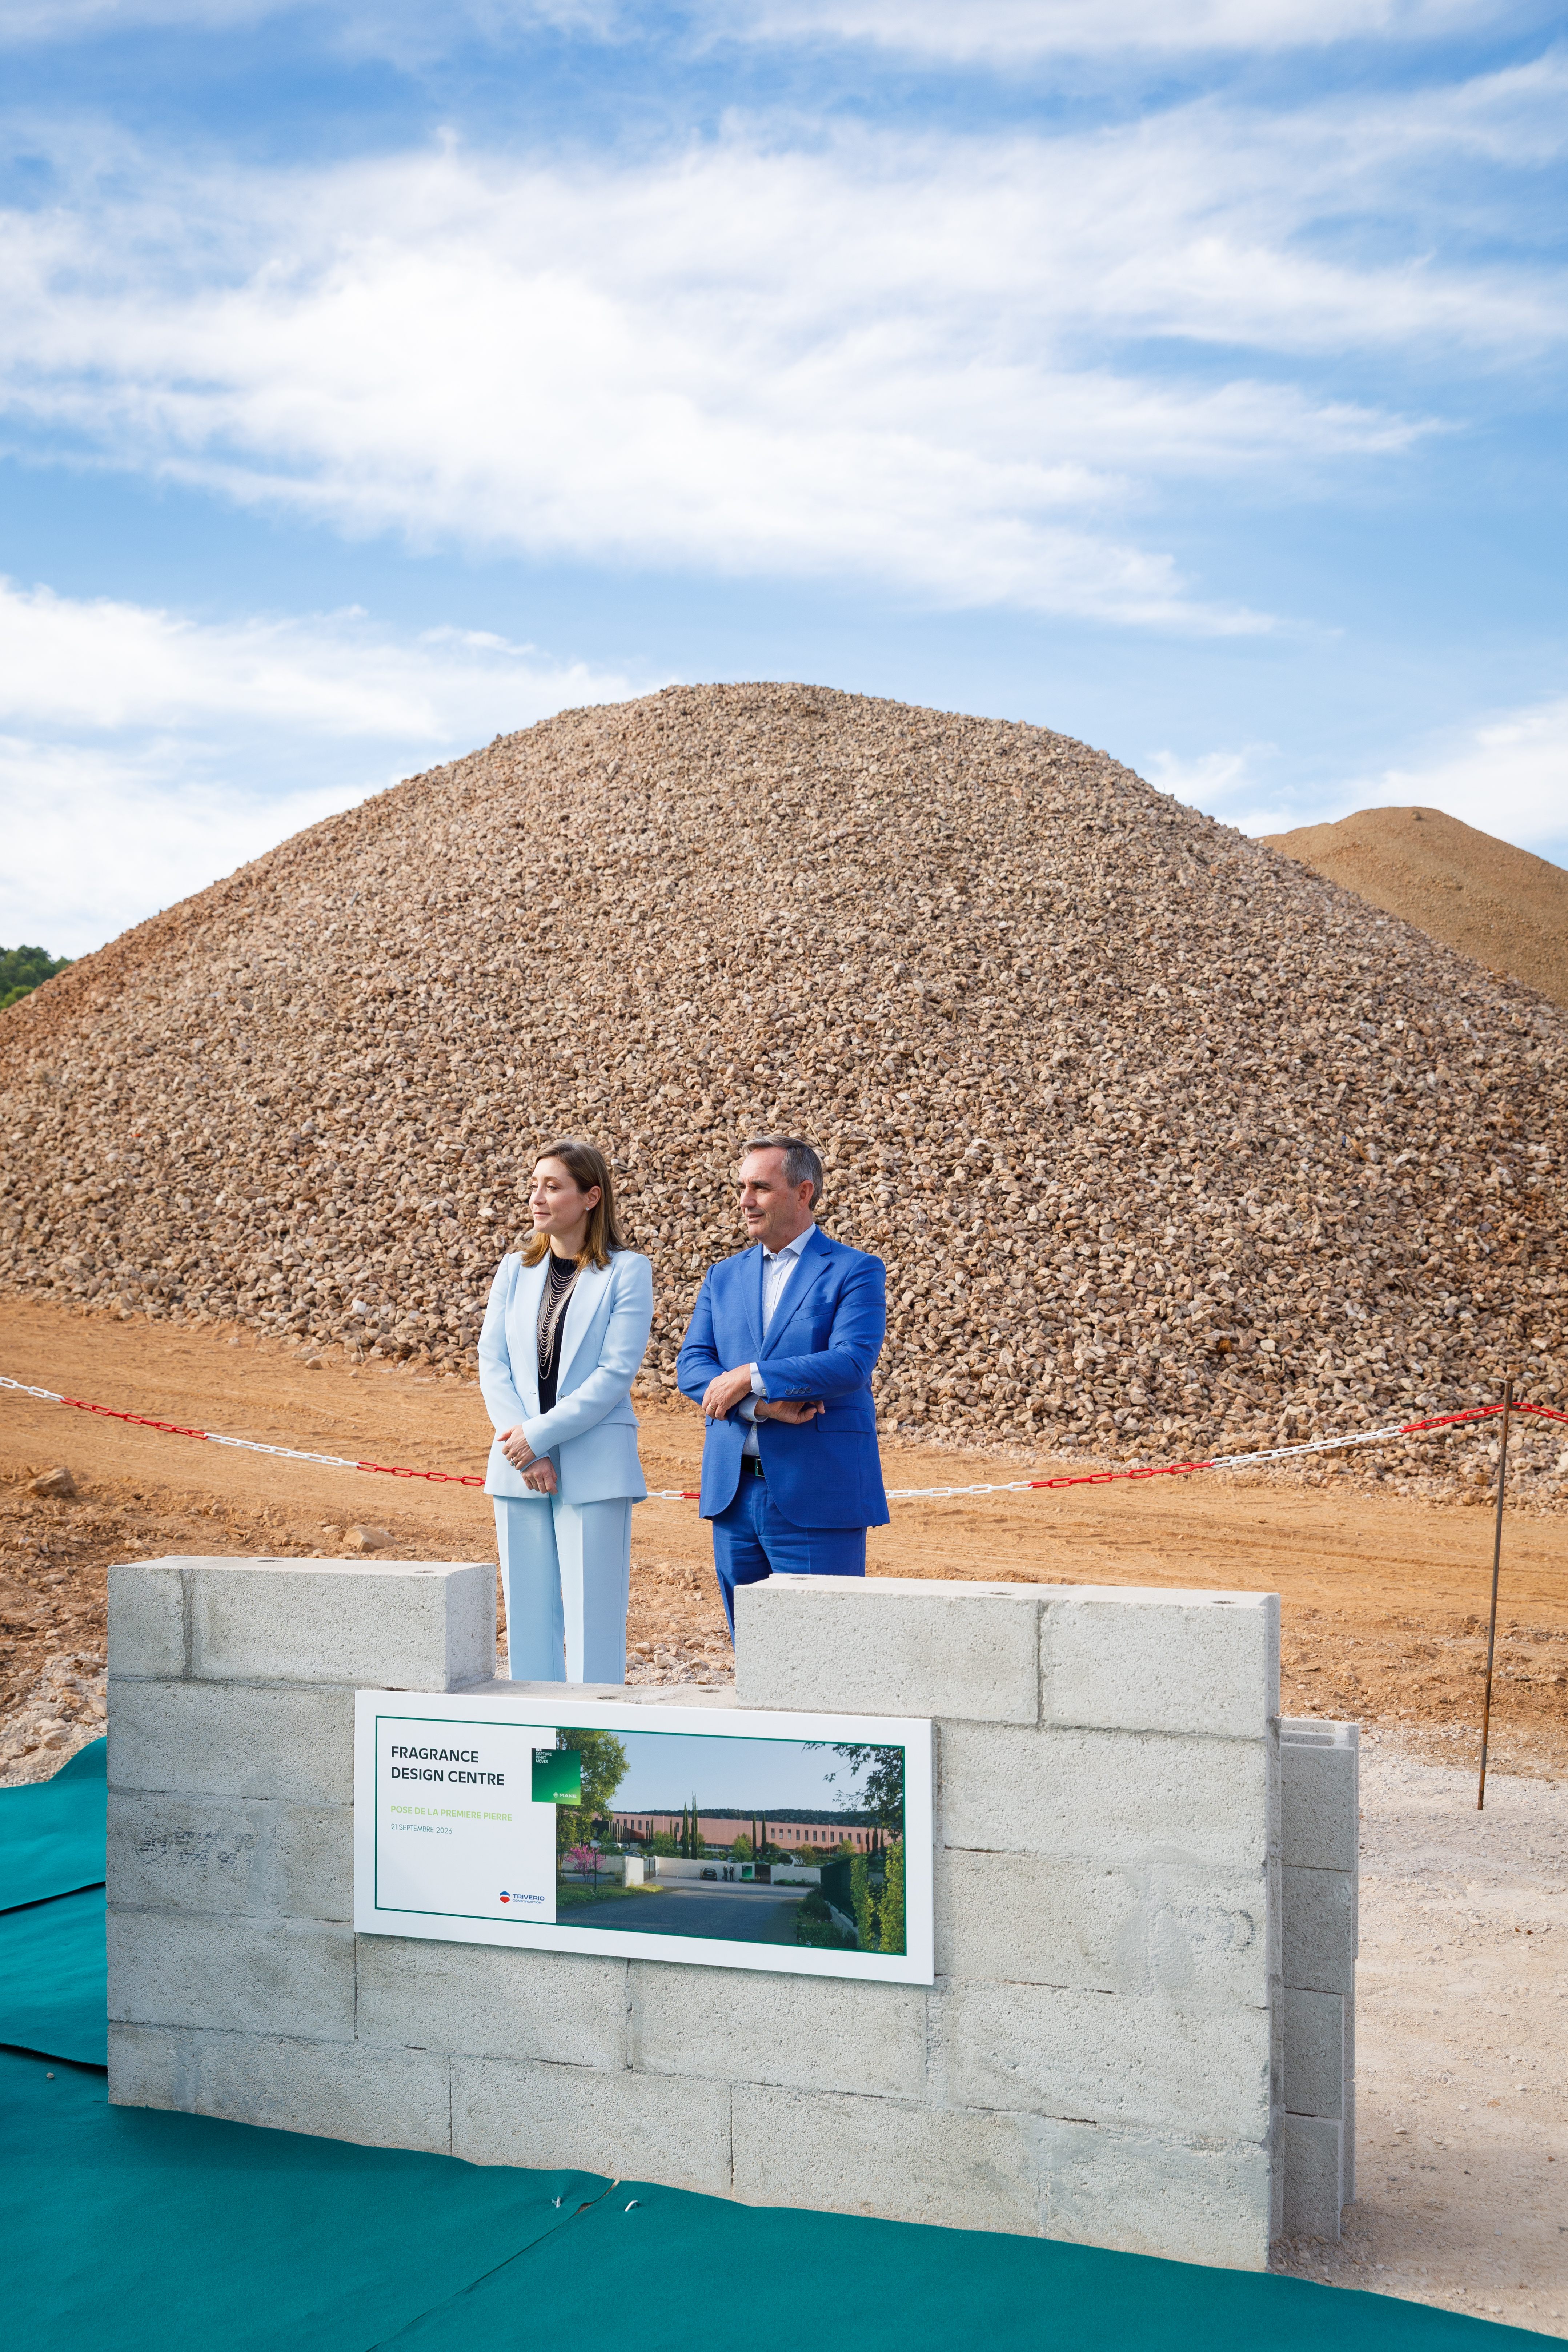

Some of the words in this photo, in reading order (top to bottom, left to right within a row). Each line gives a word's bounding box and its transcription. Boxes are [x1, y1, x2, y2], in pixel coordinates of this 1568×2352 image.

[392, 1746, 478, 1763] FRAGRANCE
[391, 1767, 444, 1781] DESIGN
[448, 1771, 504, 1786] CENTRE
[441, 1809, 481, 1819] PREMIERE
[484, 1812, 512, 1821] PIERRE
[399, 1824, 434, 1833] SEPTEMBRE
